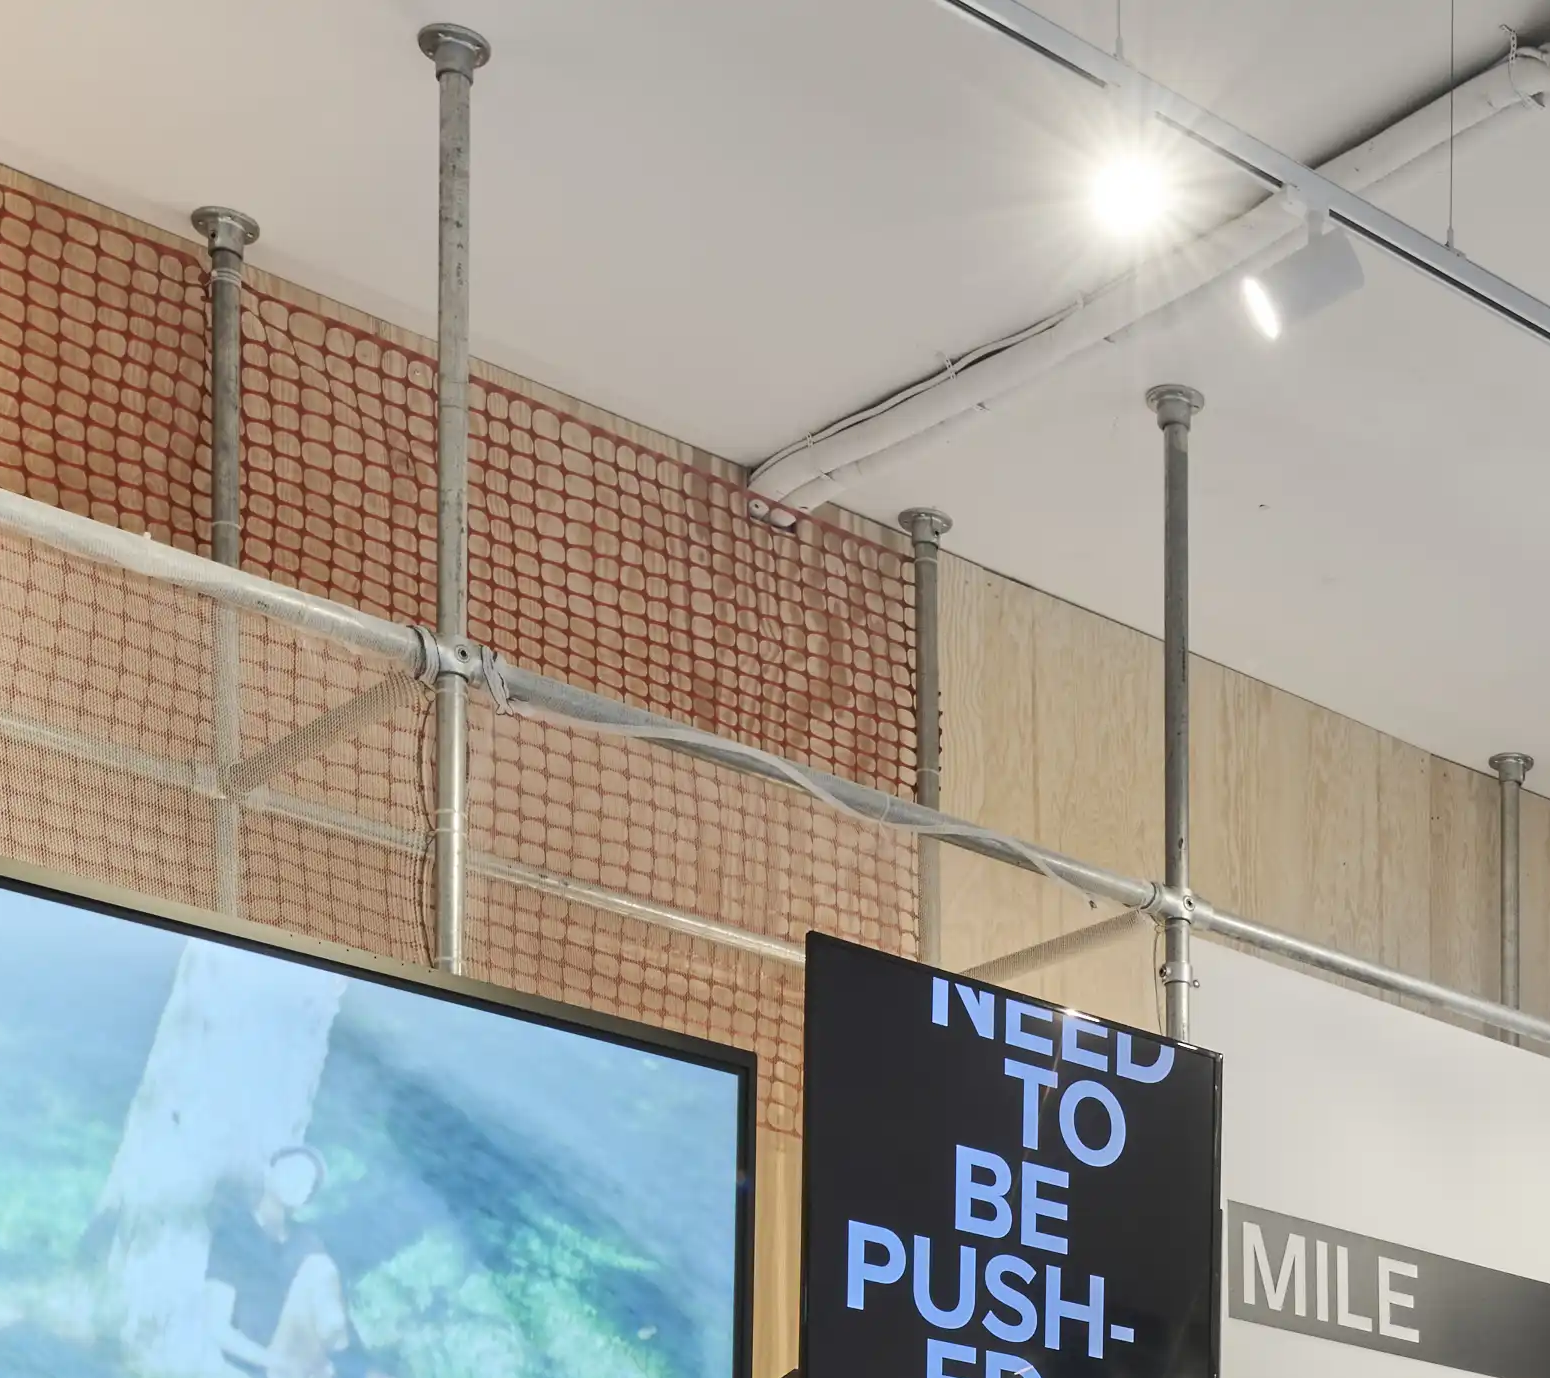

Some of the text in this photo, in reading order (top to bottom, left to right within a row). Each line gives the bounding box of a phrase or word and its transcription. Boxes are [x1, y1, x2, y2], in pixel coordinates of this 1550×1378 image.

[1004, 1058, 1126, 1167] TO
[955, 1144, 1069, 1255] BE
[847, 1219, 1135, 1359] PUSH-
[1242, 1212, 1420, 1344] MILE
